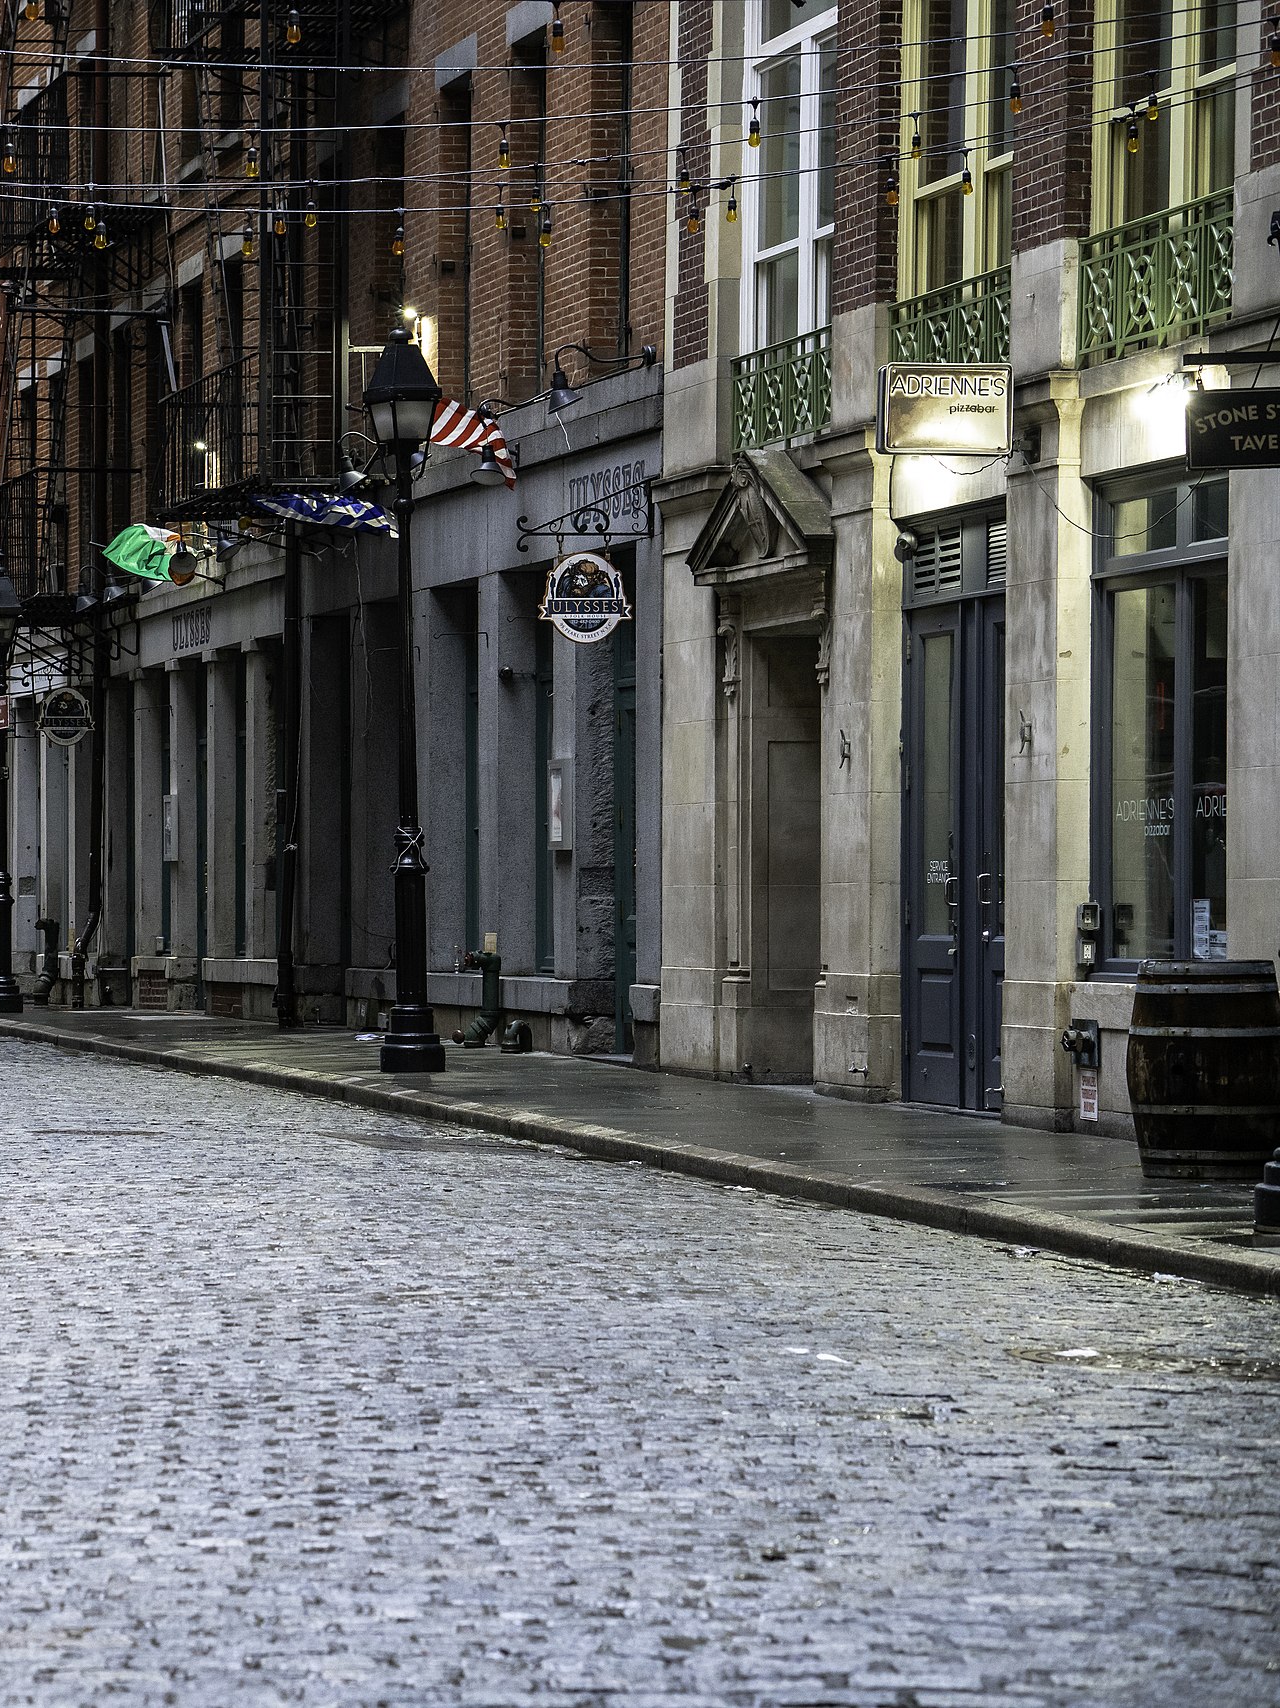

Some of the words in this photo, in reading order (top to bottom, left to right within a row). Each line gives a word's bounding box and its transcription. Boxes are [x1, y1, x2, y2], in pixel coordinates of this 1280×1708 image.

[891, 376, 1006, 397] ADRIENNE'S
[1194, 405, 1259, 434] STONE
[1116, 797, 1175, 822] ADRIENNE'S
[929, 860, 949, 872] SERVICE
